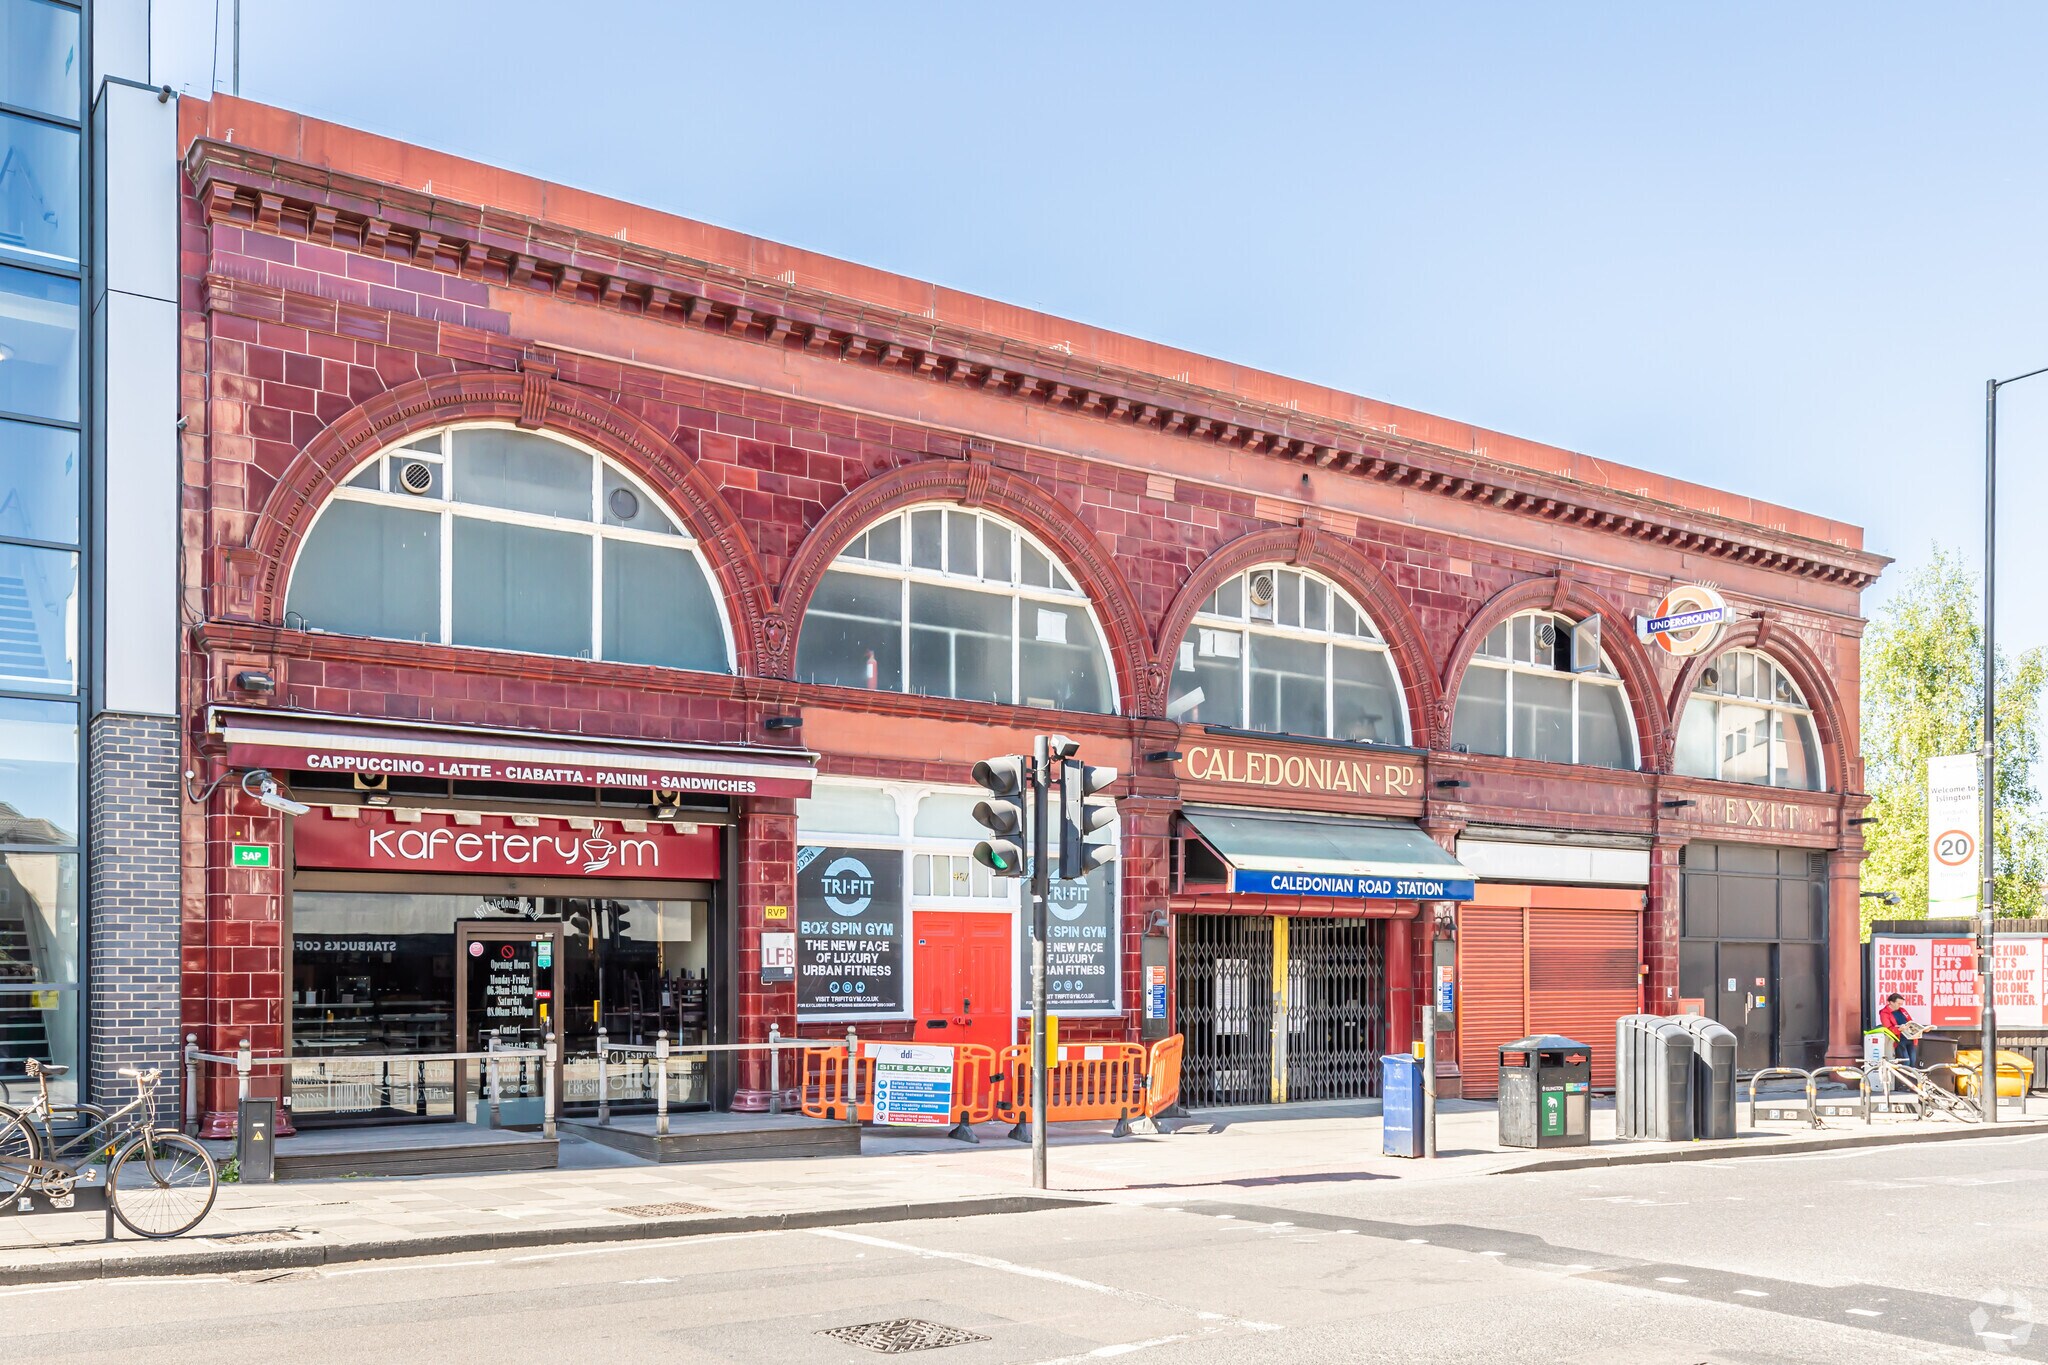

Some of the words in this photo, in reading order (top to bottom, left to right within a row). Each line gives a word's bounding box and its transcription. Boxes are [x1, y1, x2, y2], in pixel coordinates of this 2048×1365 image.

[1650, 611, 1720, 630] UNDERGROUND
[306, 754, 424, 773] CAPPUCCINO
[438, 762, 492, 778] LATTE
[505, 766, 584, 783] CIABATTA
[596, 772, 648, 787] PANINI
[660, 776, 757, 793] SANDWICHES
[1187, 747, 1372, 793] CALEDONIAN
[1930, 785, 1966, 794] Welcome
[1936, 794, 1971, 803] Islington
[1725, 798, 1800, 829] EXIT
[1941, 839, 1967, 856] 20
[241, 851, 262, 861] SAP
[1271, 875, 1353, 893] CALEDONIAN
[1358, 879, 1391, 895] ROAD
[1396, 880, 1444, 896] STATION
[767, 908, 785, 917] RVP
[801, 921, 829, 935] BOX
[831, 922, 862, 935] SPIN
[865, 922, 893, 936] GYM
[1028, 926, 1052, 938] BX
[1054, 926, 1080, 938] SPIN
[1083, 926, 1107, 938] GYM
[805, 939, 830, 951] THE
[831, 940, 858, 951] NEW
[860, 940, 890, 952] FACE
[1053, 942, 1078, 953] NEW
[1079, 942, 1104, 953] FACE
[1879, 944, 1891, 956] BE
[1893, 944, 1918, 956] KIND.
[1933, 944, 1946, 957] BE
[1947, 944, 1974, 957] KIND.
[2003, 945, 2029, 956] KIND.
[766, 947, 794, 965] LFB
[816, 953, 831, 964] OF
[833, 953, 879, 964] LUXURY
[1056, 954, 1095, 964] LUXURY
[1879, 957, 1907, 968] LET'S
[1933, 957, 1962, 969] LET'S
[1993, 957, 2017, 969] ET'S
[803, 965, 843, 976] URBAN
[845, 965, 892, 976] FITNESS
[1065, 965, 1106, 976] FITNESS
[1879, 969, 1904, 981] LOOK
[1905, 969, 1924, 981] OUT
[1933, 969, 1959, 982] LOOK
[1959, 969, 1978, 982] OUT
[1995, 969, 2014, 981] OOK
[2016, 969, 2035, 981] OUT
[1879, 982, 1898, 993] FOR
[1899, 982, 1918, 993] ONE
[1933, 982, 1953, 994] FOR
[1954, 982, 1974, 994] ONE
[1993, 982, 2008, 993] OR
[2010, 982, 2029, 993] ONE
[497, 996, 522, 1006] Saturday
[499, 1024, 521, 1034] Contact
[900, 1049, 913, 1059] ddi
[907, 1065, 950, 1073] SAFETY
